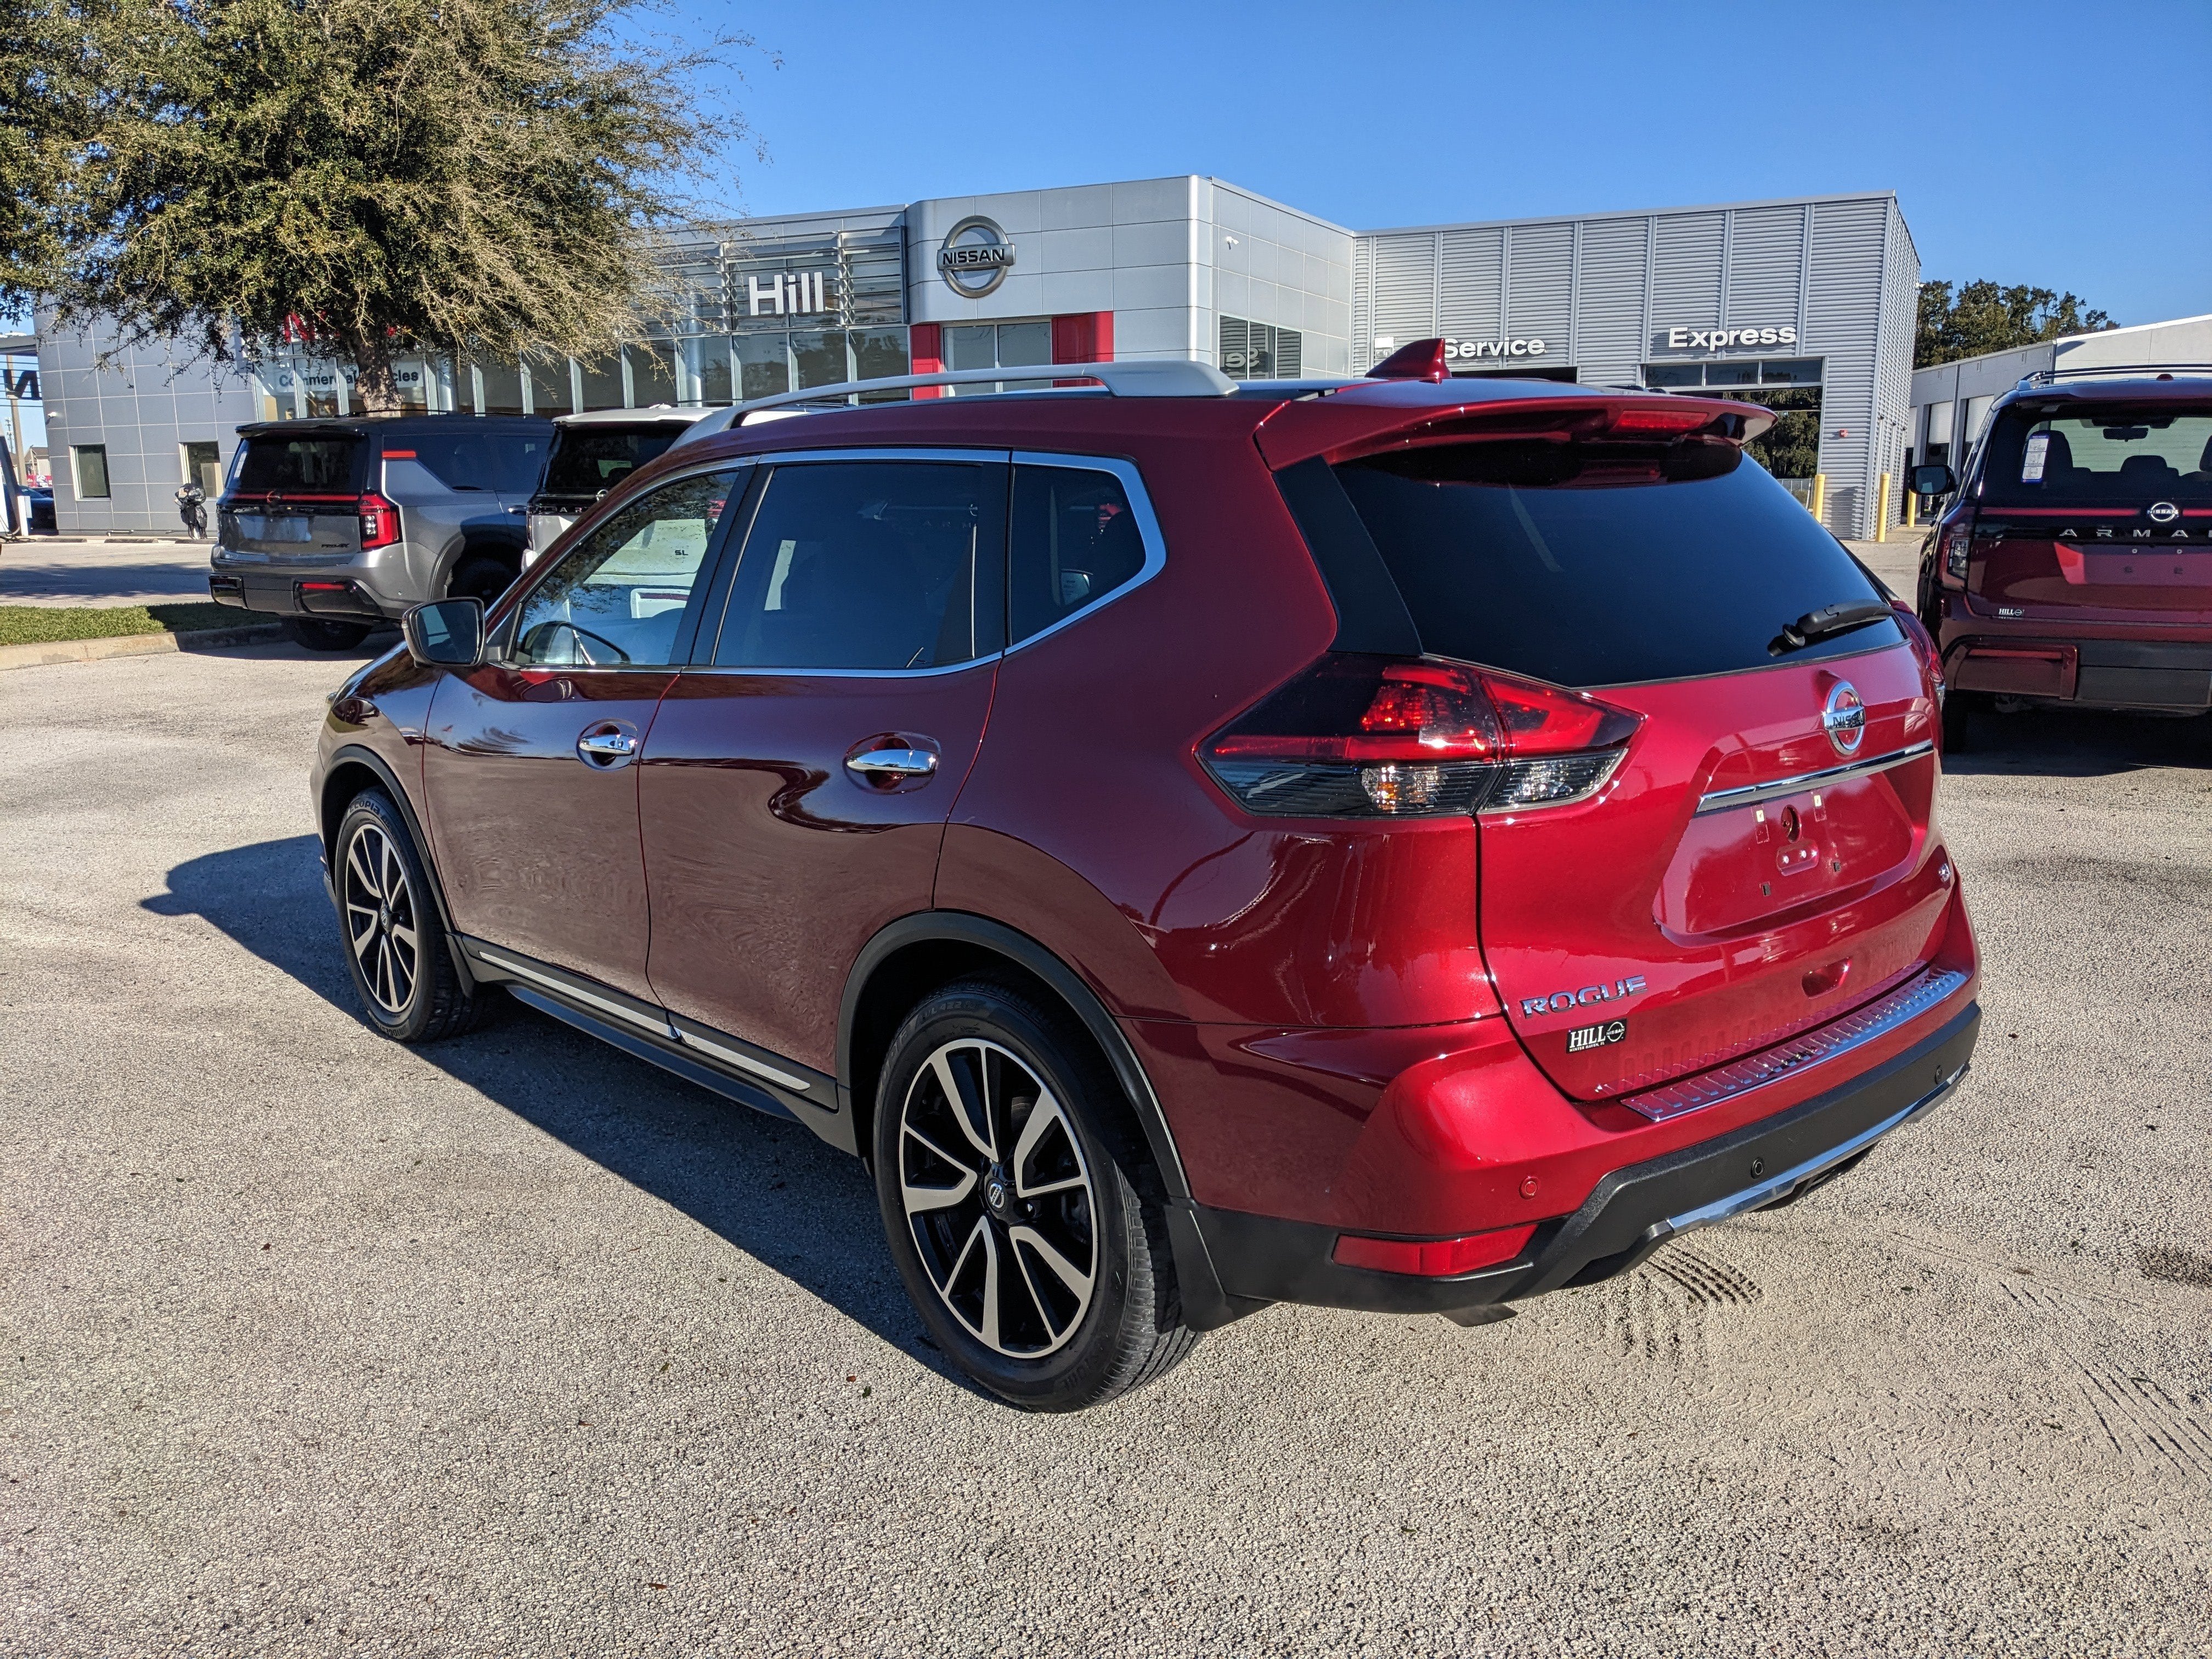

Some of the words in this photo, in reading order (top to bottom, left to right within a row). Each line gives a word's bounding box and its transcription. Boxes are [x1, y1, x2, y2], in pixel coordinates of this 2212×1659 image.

[943, 248, 1005, 265] NISSAN
[749, 272, 824, 316] Hill
[1444, 336, 1545, 359] Service
[1669, 326, 1797, 351] Express
[2059, 528, 2212, 538] ARMA
[1520, 975, 1648, 1019] ROGUE
[1570, 1025, 1606, 1048] HILL
[1606, 1028, 1625, 1036] NISSAN
